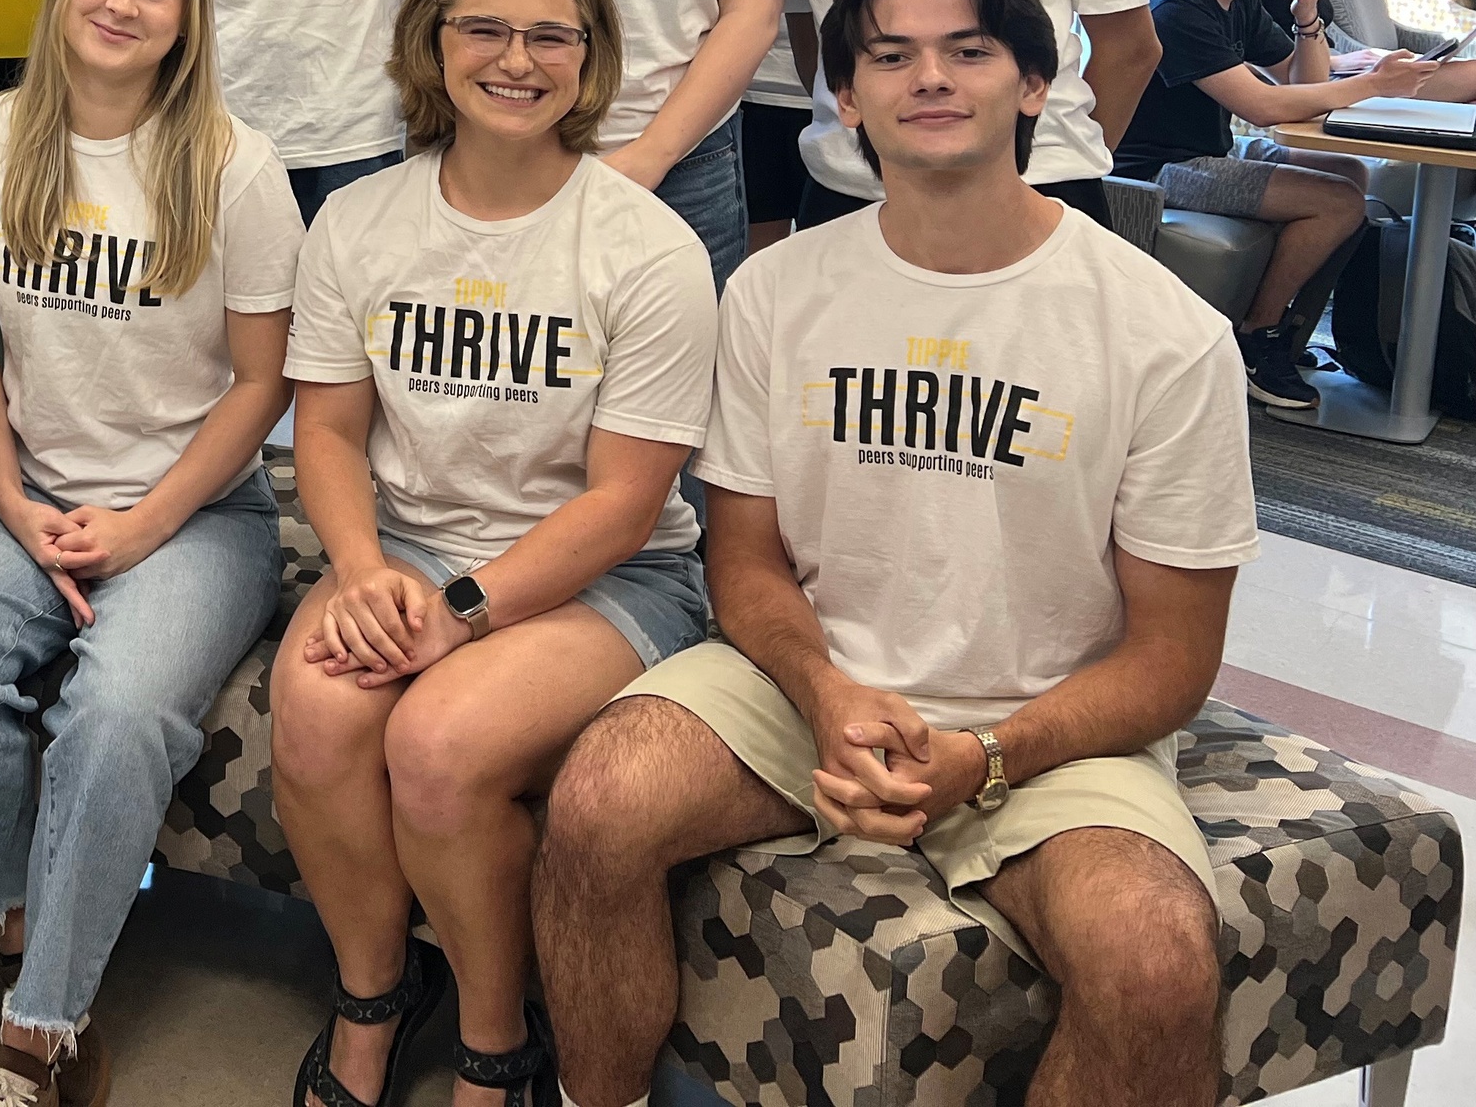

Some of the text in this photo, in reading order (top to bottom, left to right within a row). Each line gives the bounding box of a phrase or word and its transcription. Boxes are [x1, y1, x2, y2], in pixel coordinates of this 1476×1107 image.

[16, 291, 131, 321] peers supporting peers
[455, 277, 507, 308] TIPPIE
[389, 301, 573, 388] THRIVE
[905, 336, 971, 370] TIPPIE
[408, 378, 539, 404] peers supporting peers
[828, 367, 1040, 467] THRIVE
[858, 449, 995, 481] peers supporting peers
